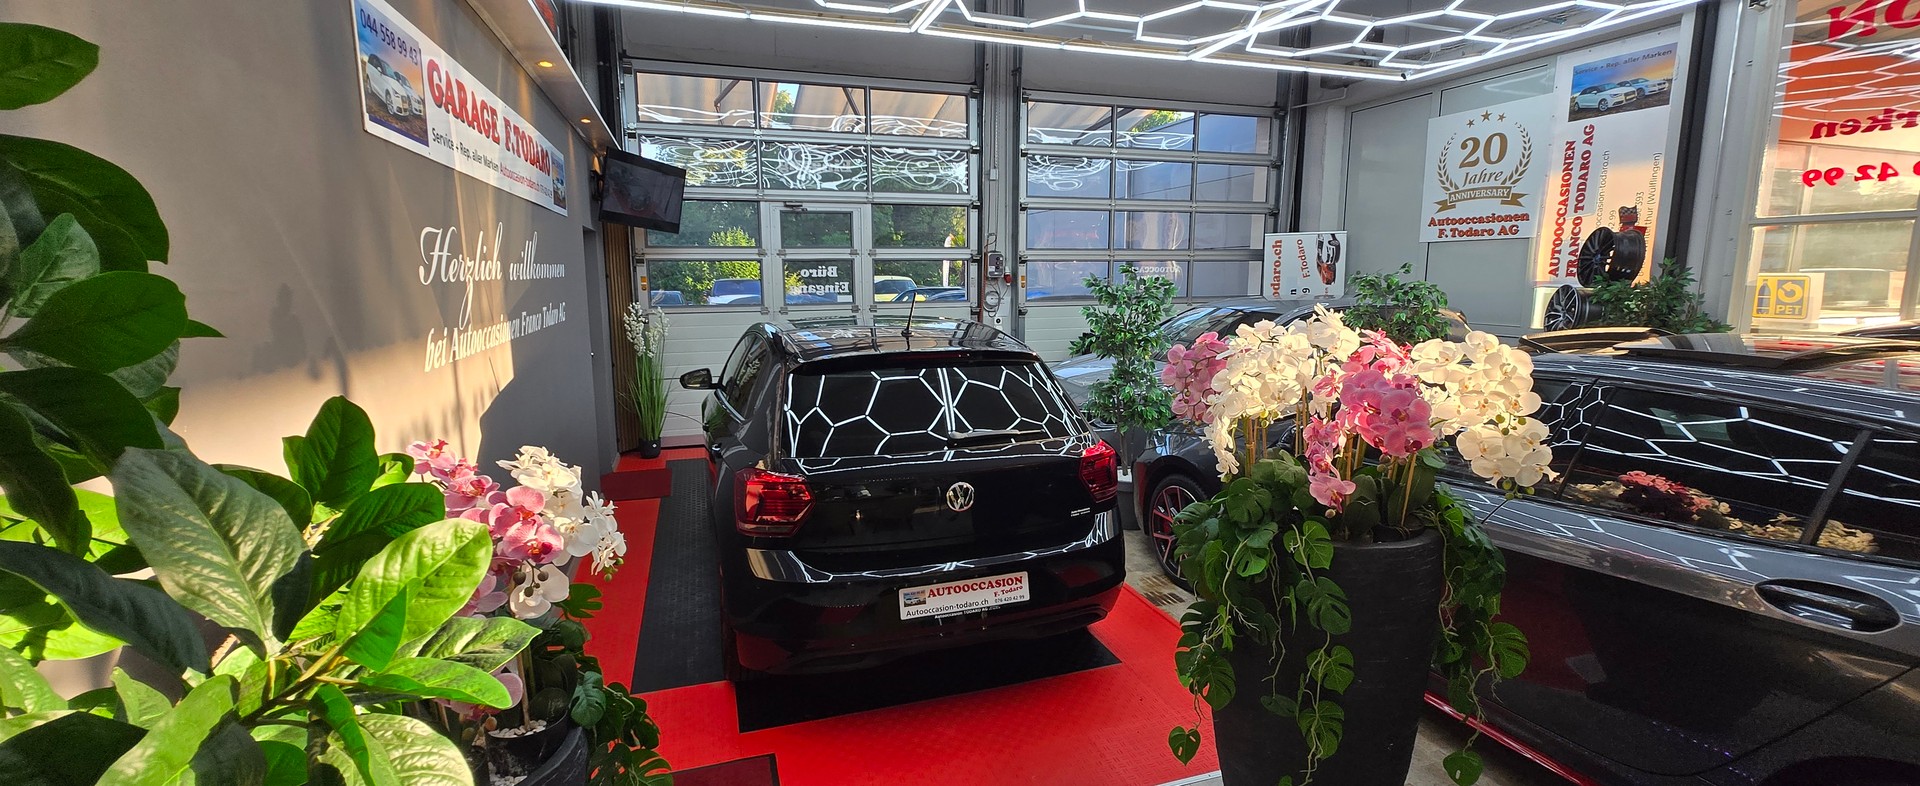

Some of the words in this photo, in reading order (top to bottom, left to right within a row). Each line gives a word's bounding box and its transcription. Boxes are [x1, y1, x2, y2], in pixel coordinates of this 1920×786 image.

[360, 8, 378, 38] 044
[380, 22, 396, 50] 558
[397, 36, 408, 58] 99
[409, 46, 418, 66] 43
[1606, 61, 1621, 69] Rep.
[1622, 56, 1640, 64] aller
[1642, 49, 1672, 60] Marken
[427, 58, 500, 146] GARAGE
[1582, 123, 1595, 146] AG
[432, 127, 454, 151] Service
[459, 140, 471, 162] Rep.
[472, 147, 483, 165] aller
[483, 154, 499, 173] Marken
[1458, 132, 1508, 169] 20
[1462, 167, 1504, 188] Jahre
[1574, 149, 1592, 214] TODARO
[1449, 188, 1510, 202] ANNIVERSARY
[1596, 150, 1610, 229] occasion-todaro.ch
[1636, 191, 1645, 206] 393
[1427, 213, 1530, 227] Autooccasionen
[1548, 140, 1576, 278] AUTOOCCASIONEN
[1437, 228, 1449, 239] F.
[1449, 227, 1495, 238] Todaro
[1497, 224, 1520, 236] AG
[1565, 215, 1583, 278] FRANCO
[418, 221, 503, 331] Herzlich
[509, 231, 565, 281] willkommen
[1775, 304, 1800, 315] PET
[424, 327, 448, 372] bei
[448, 314, 520, 363] Autooccasionen
[521, 311, 541, 336] Franco
[542, 302, 559, 328] Todaro
[559, 301, 566, 322] AG
[927, 576, 1023, 598] AUTOOCCASION
[1001, 585, 1023, 595] Todaro
[906, 598, 989, 617] Autooccasion-todaro.ch
